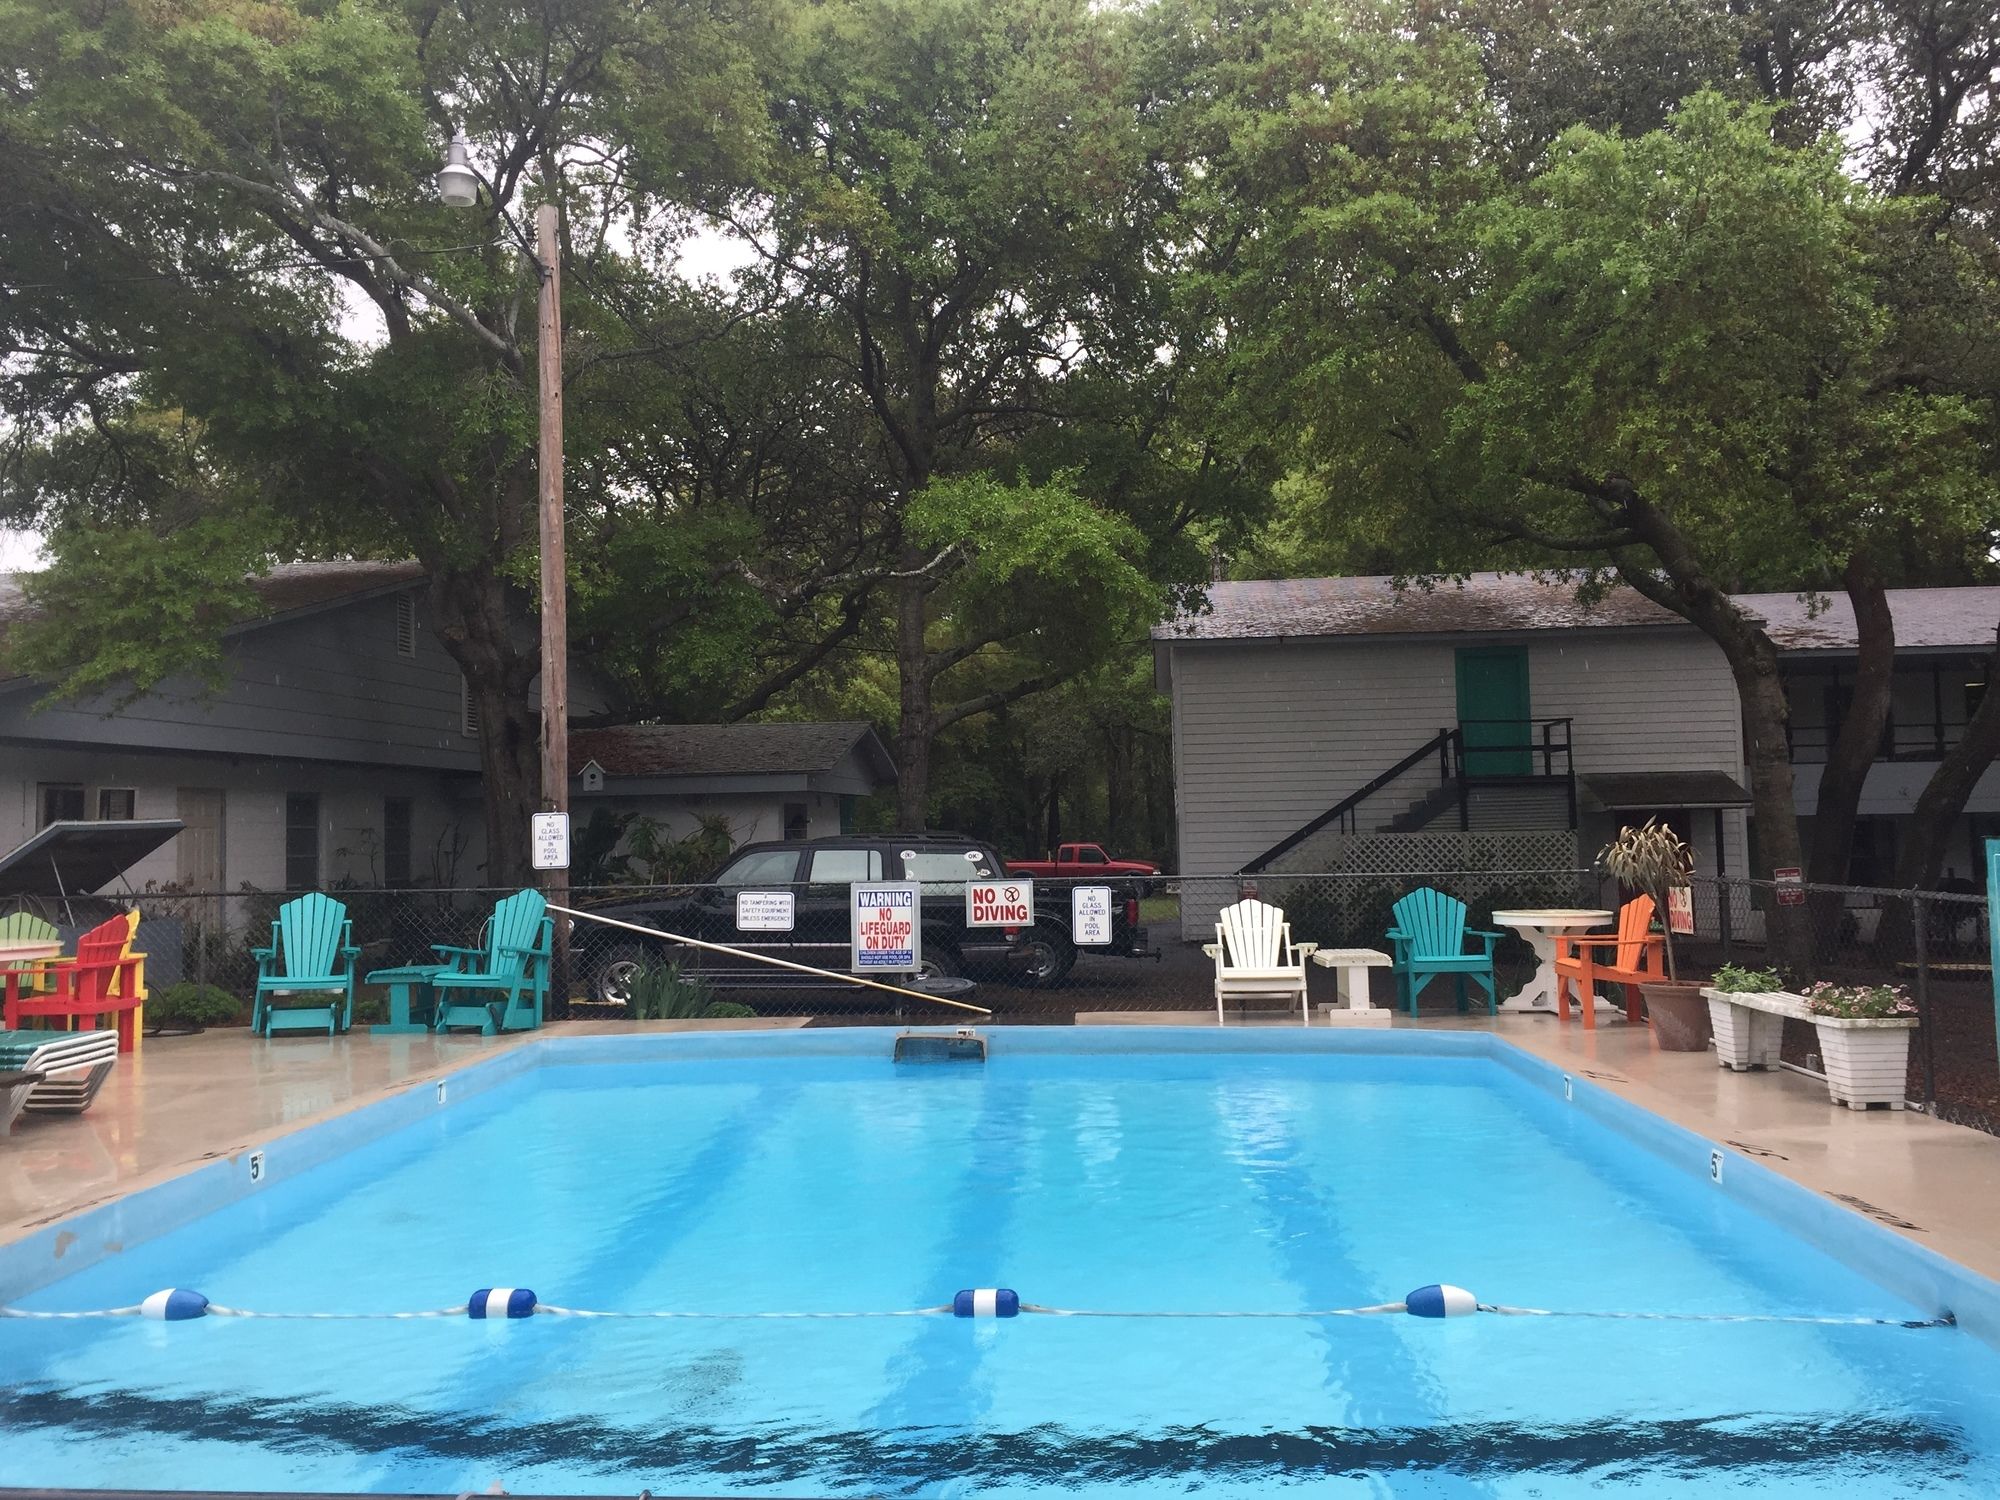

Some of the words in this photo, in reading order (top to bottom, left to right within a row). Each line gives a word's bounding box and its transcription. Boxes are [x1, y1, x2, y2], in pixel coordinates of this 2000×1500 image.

[860, 892, 911, 906] WARNING
[973, 888, 995, 904] NO
[879, 908, 892, 921] NO
[974, 905, 1028, 921] DIVING
[1671, 910, 1692, 929] DIVING
[860, 922, 910, 935] LIFEGUARD
[866, 937, 878, 949] ON
[882, 936, 905, 949] DUTY
[251, 1156, 259, 1179] 5
[1712, 1152, 1717, 1178] 5
